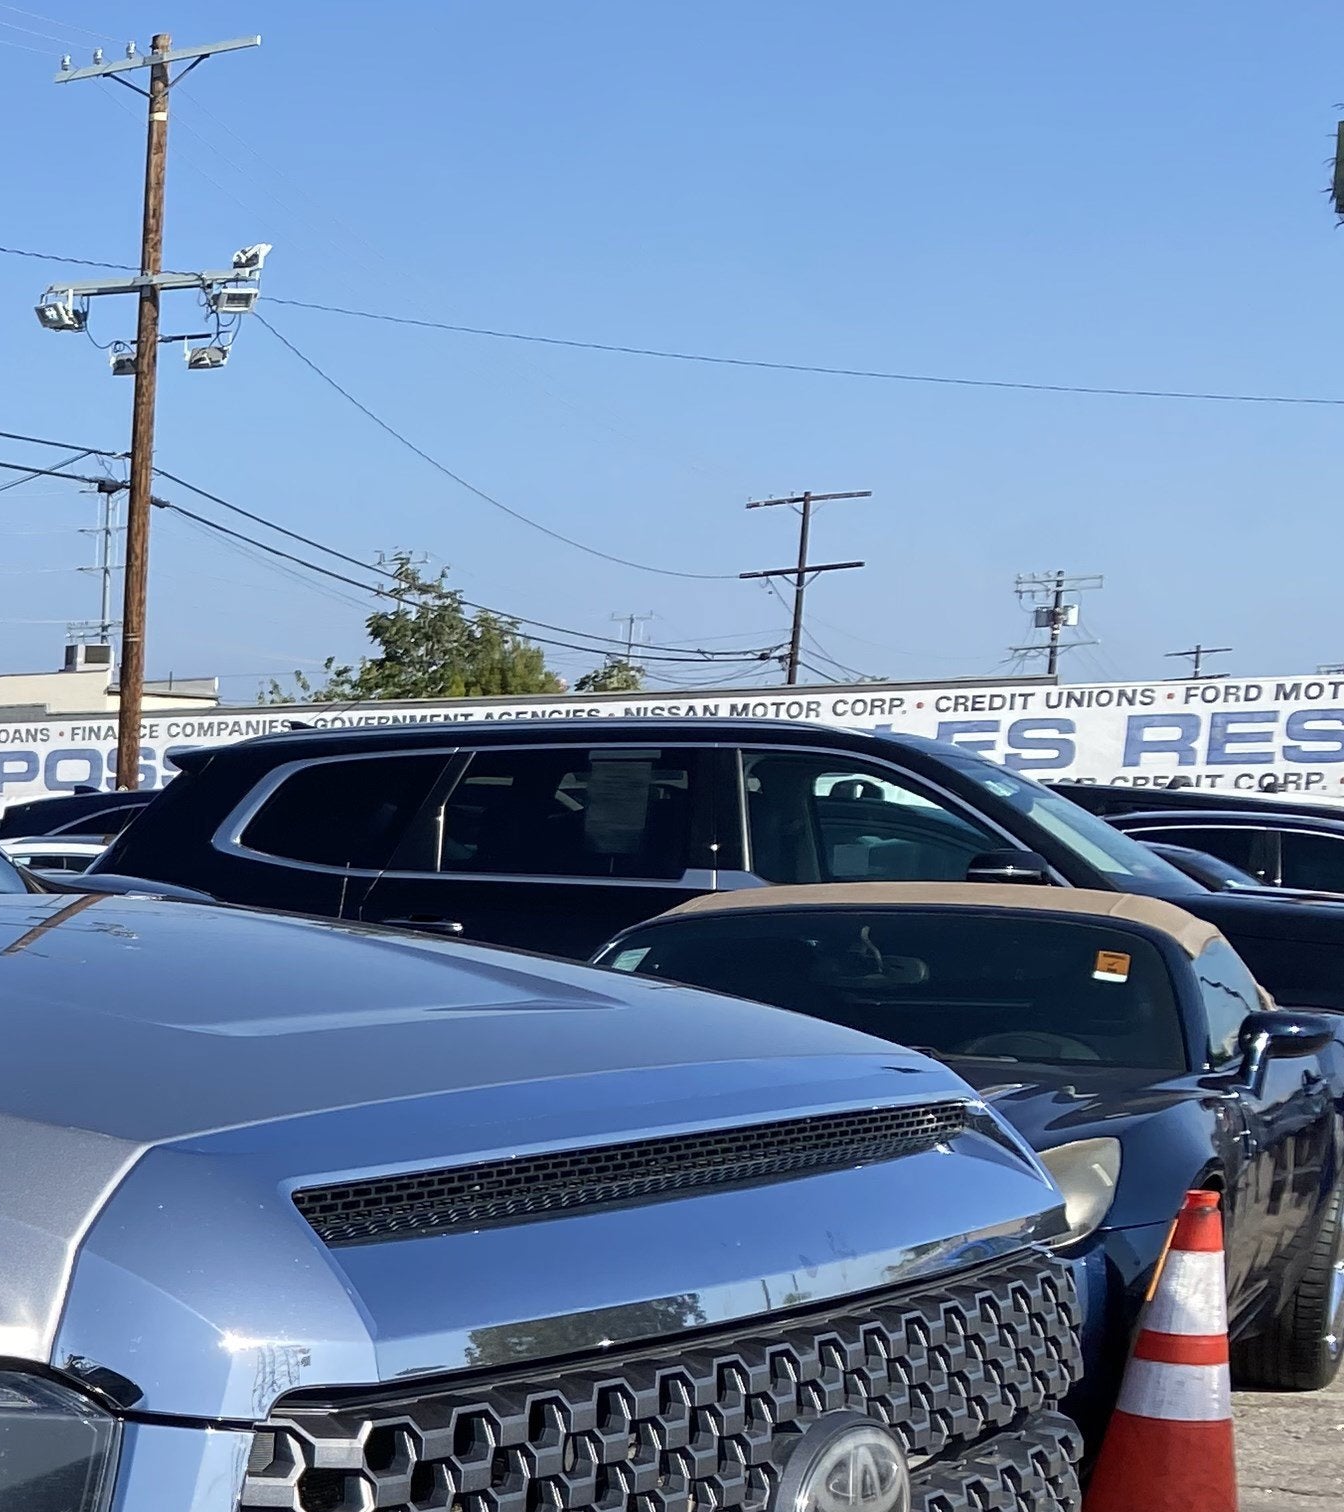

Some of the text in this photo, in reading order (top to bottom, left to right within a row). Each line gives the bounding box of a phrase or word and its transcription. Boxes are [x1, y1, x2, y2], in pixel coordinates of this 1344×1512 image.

[70, 723, 160, 742] FINACE
[167, 719, 292, 738] COMPANIES
[729, 700, 822, 719] MOTOR
[832, 698, 907, 718] CORP.
[935, 692, 1035, 713] CREDIT
[1045, 688, 1156, 709] UNIONS
[1184, 683, 1263, 704] FORD
